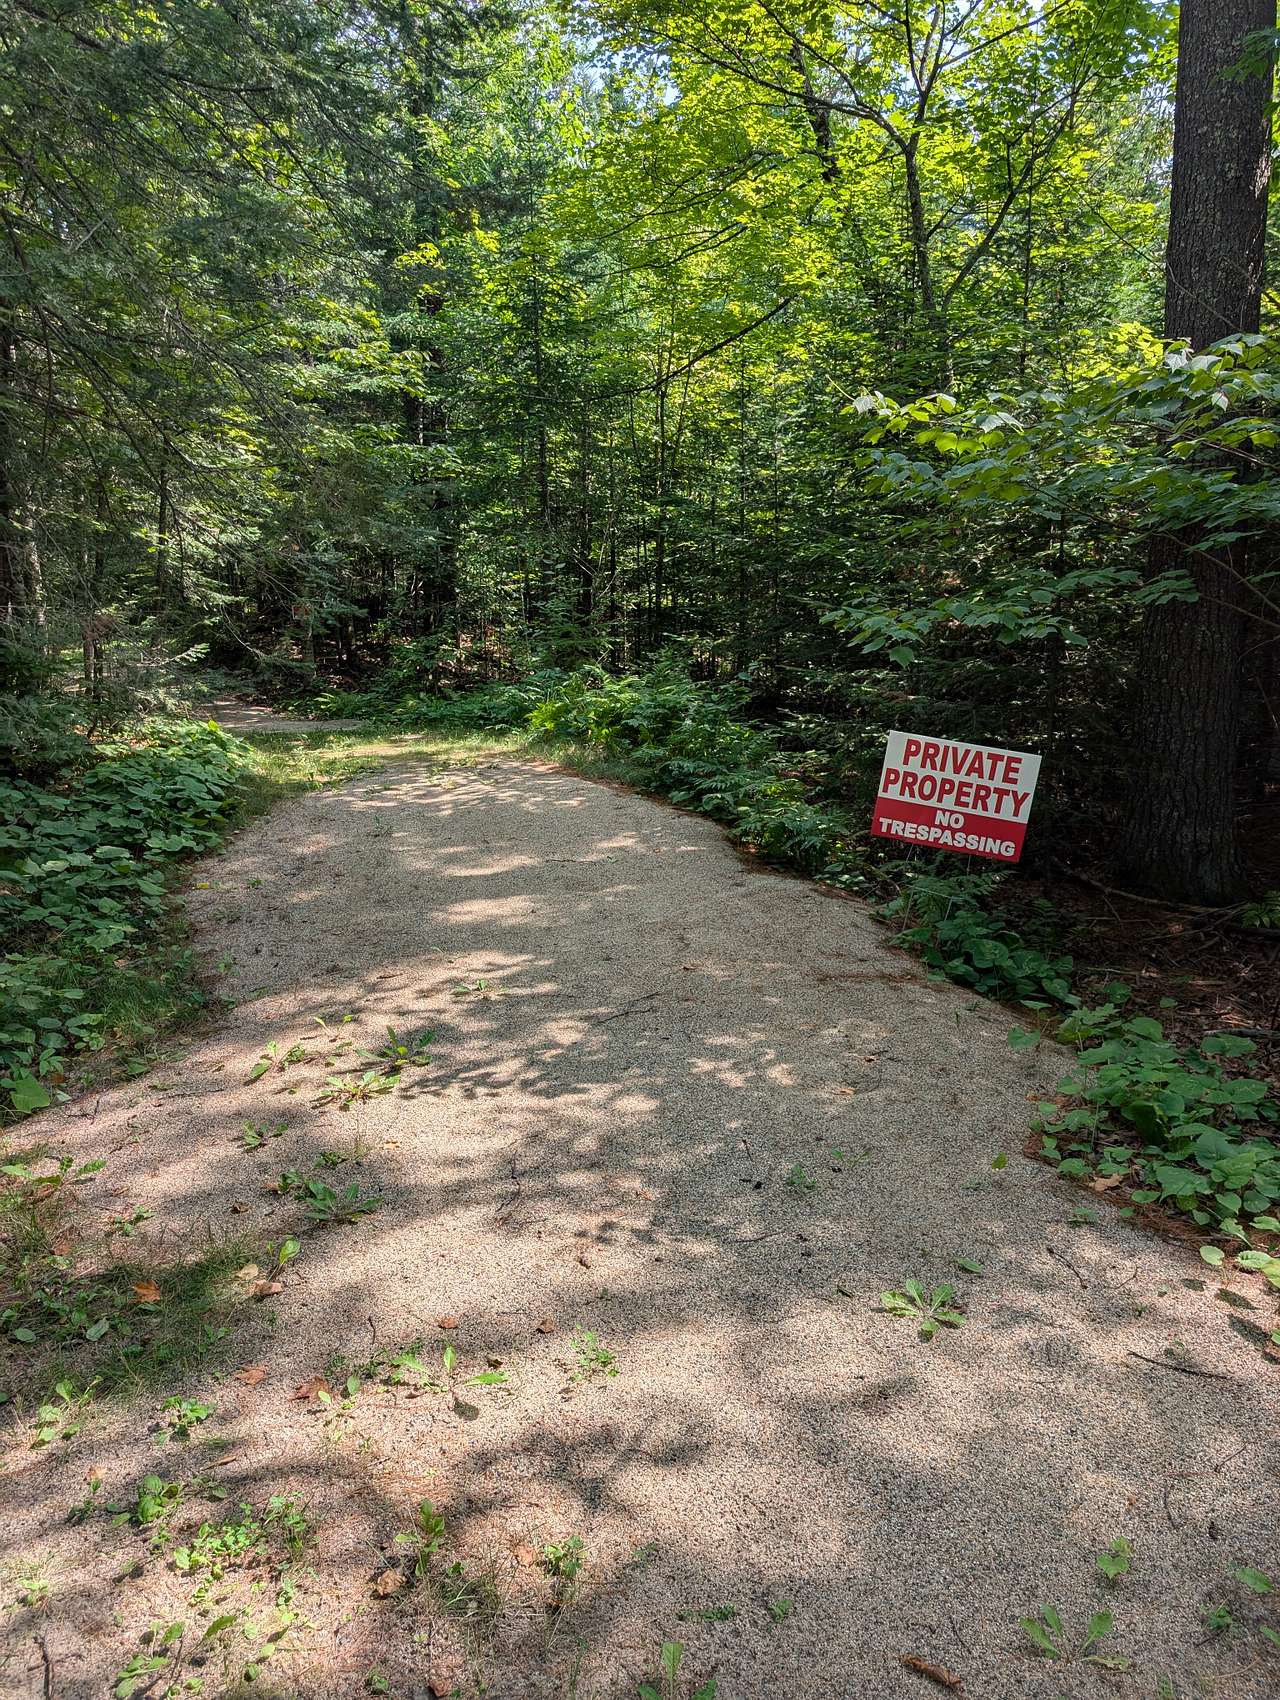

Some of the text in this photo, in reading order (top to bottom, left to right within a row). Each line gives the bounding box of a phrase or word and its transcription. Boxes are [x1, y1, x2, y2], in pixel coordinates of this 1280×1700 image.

[903, 739, 1023, 784] PRIVATE
[882, 768, 1030, 817] PROPERTY
[880, 818, 1015, 856] TRESPASSING
[935, 810, 964, 828] NO
